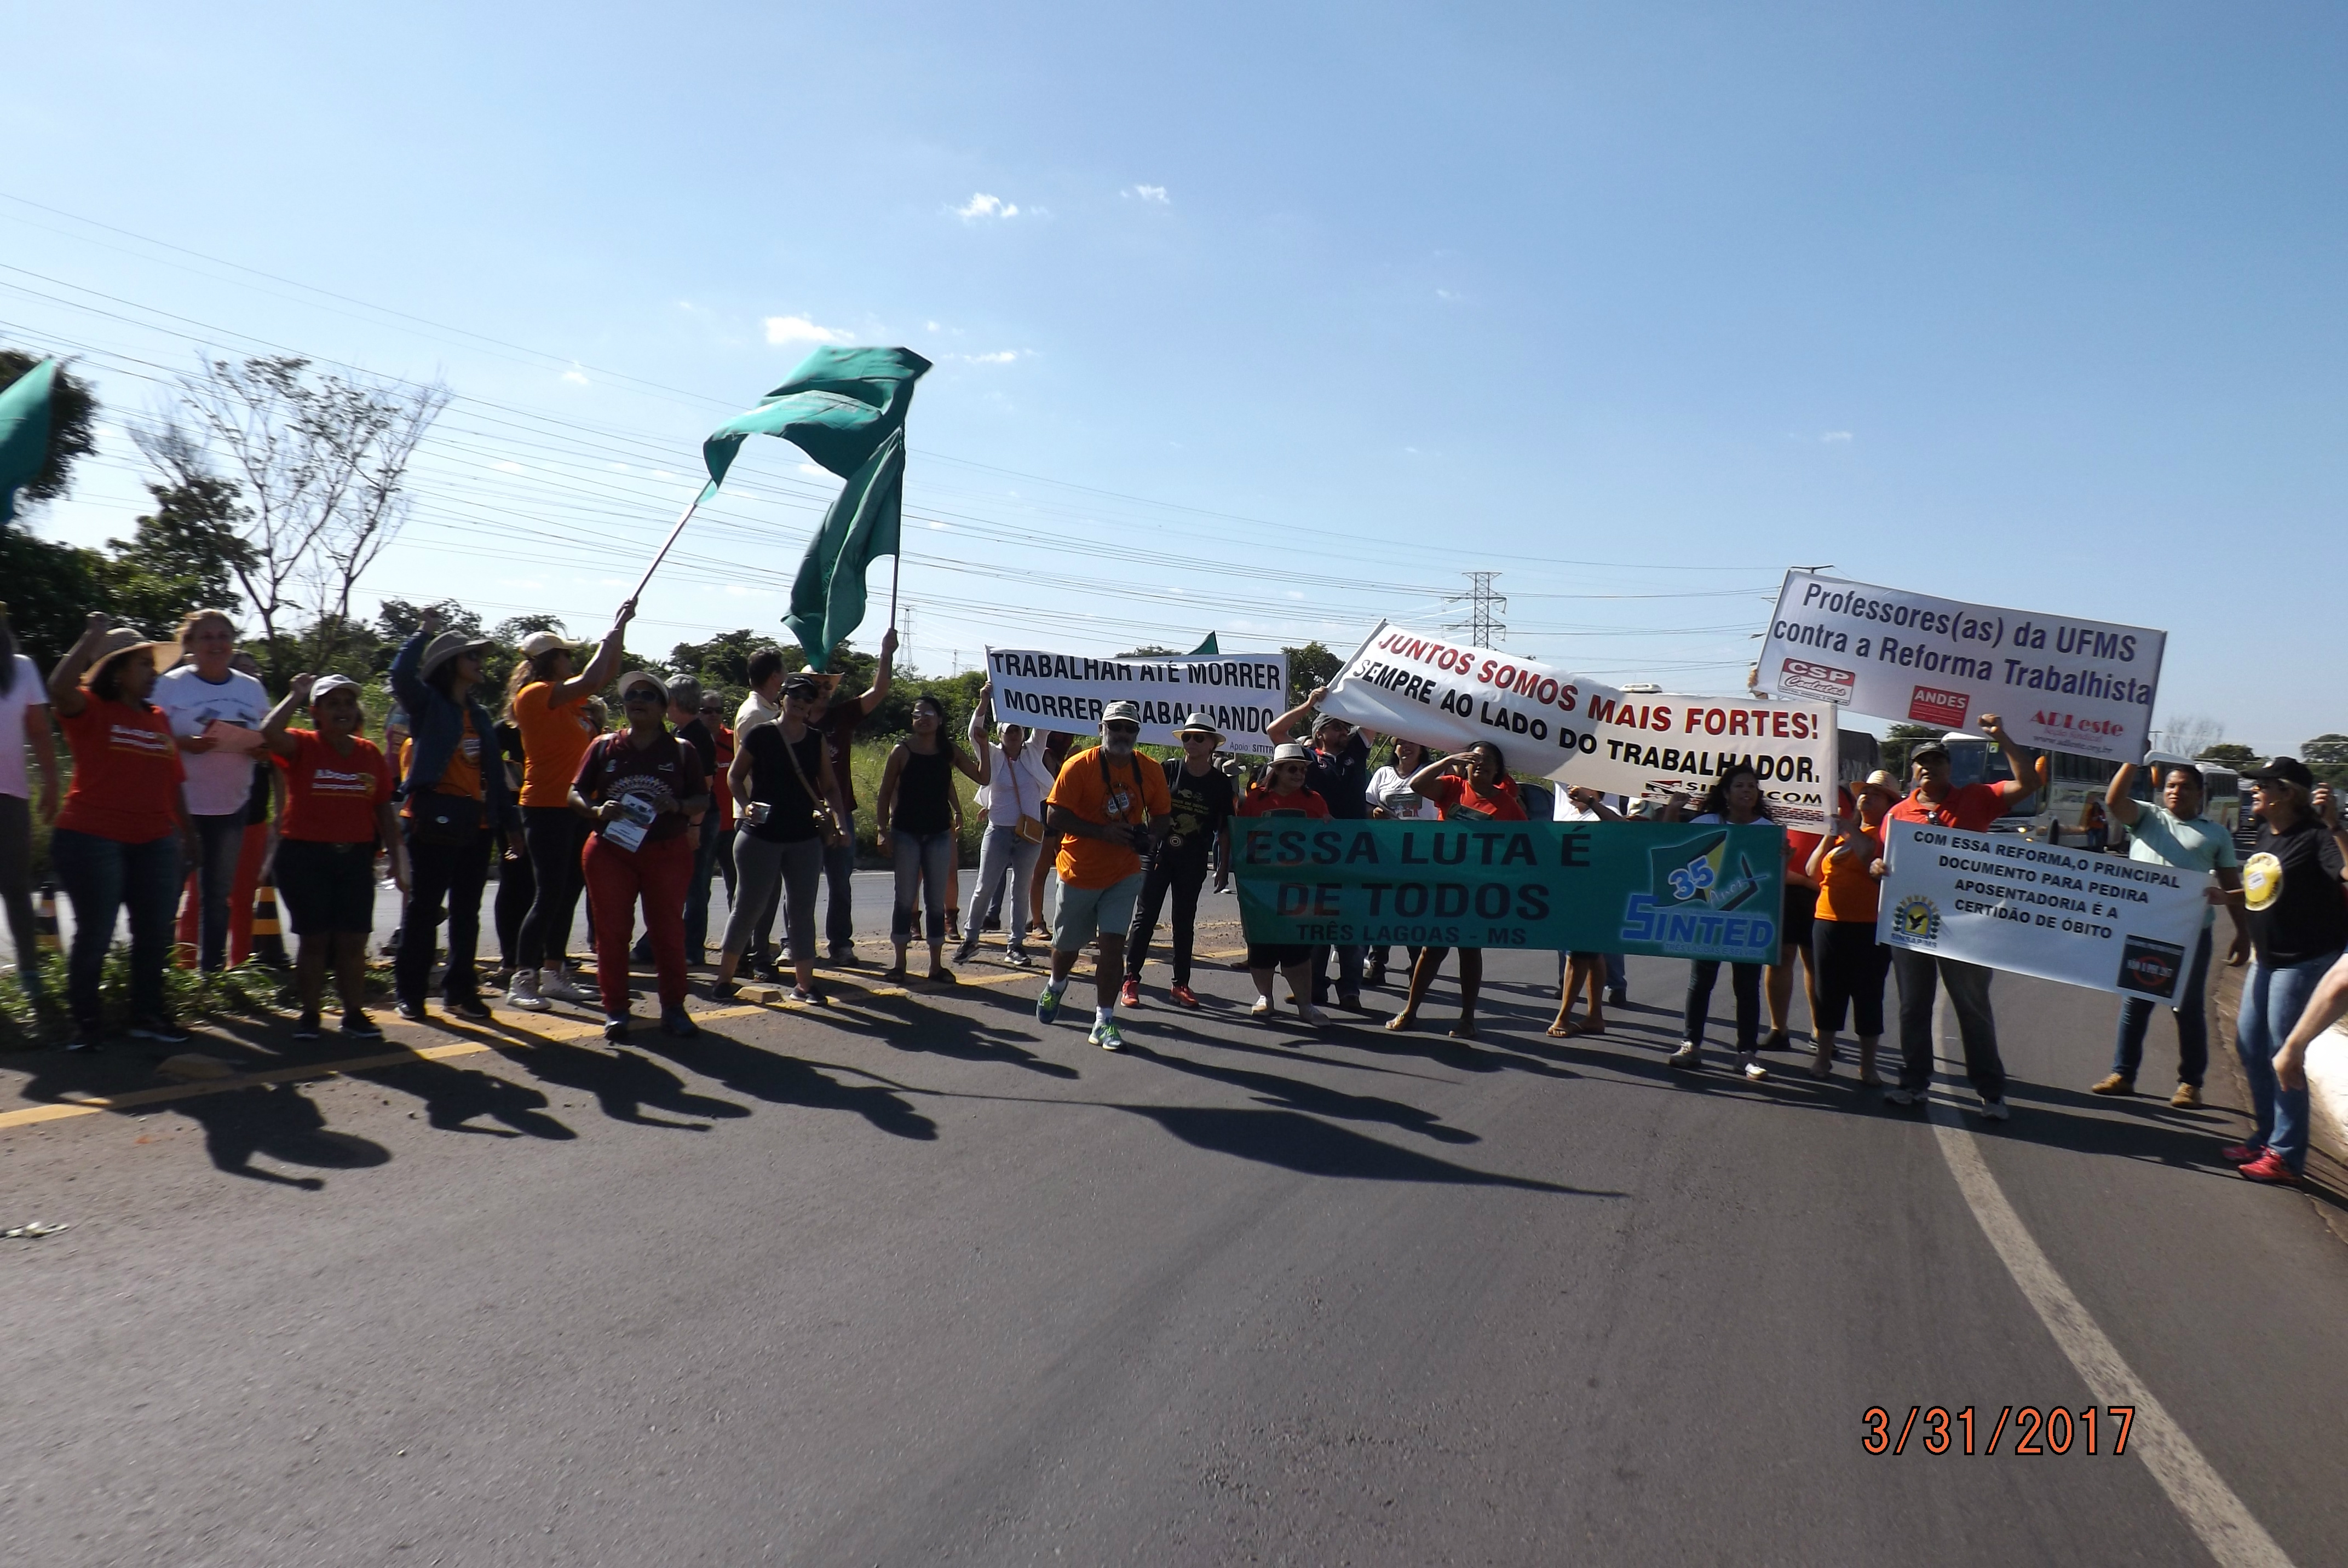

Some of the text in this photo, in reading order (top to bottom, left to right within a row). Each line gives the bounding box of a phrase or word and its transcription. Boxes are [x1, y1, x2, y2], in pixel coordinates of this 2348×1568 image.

[1803, 583, 2138, 662] Professores(as) da UFMS
[990, 653, 1281, 690] TRABALHAR ATÉ MORRER
[1773, 620, 2152, 705] contra a Reforma Trabalhista
[1787, 662, 1850, 681] CSP
[1003, 688, 1103, 723] MORRER
[1353, 659, 1437, 705] SEMPRE
[1440, 689, 1474, 718] AO
[1480, 701, 1548, 740] LADO
[1559, 727, 1597, 754] DO
[1378, 633, 1818, 740] JUNTOS SOMOS MAIS FORTES!
[1914, 689, 1967, 709] ANDES
[2029, 710, 2124, 737] ADLeste
[1229, 741, 1275, 754] Apoio: SITITR
[1317, 755, 1327, 769] 5
[1246, 825, 1591, 867] ESSA LUTA É
[1913, 831, 1947, 846] COM
[1951, 837, 1990, 854] ESSA
[2093, 861, 2180, 889] PRINCIPAL
[1667, 855, 1715, 901] 35
[1938, 855, 2149, 903] DOCUMENTO PARA PEDIRA
[1276, 882, 1550, 920] DE TODOS
[1954, 879, 2119, 919] APOSENTADORIA É A
[1954, 899, 2113, 939] CERTIDÃO DE ÓBITO
[1296, 921, 1354, 941] TRÊS
[1362, 925, 1460, 943] LAGOAS
[1487, 927, 1527, 945] MS
[1621, 893, 1775, 948] SINTED
